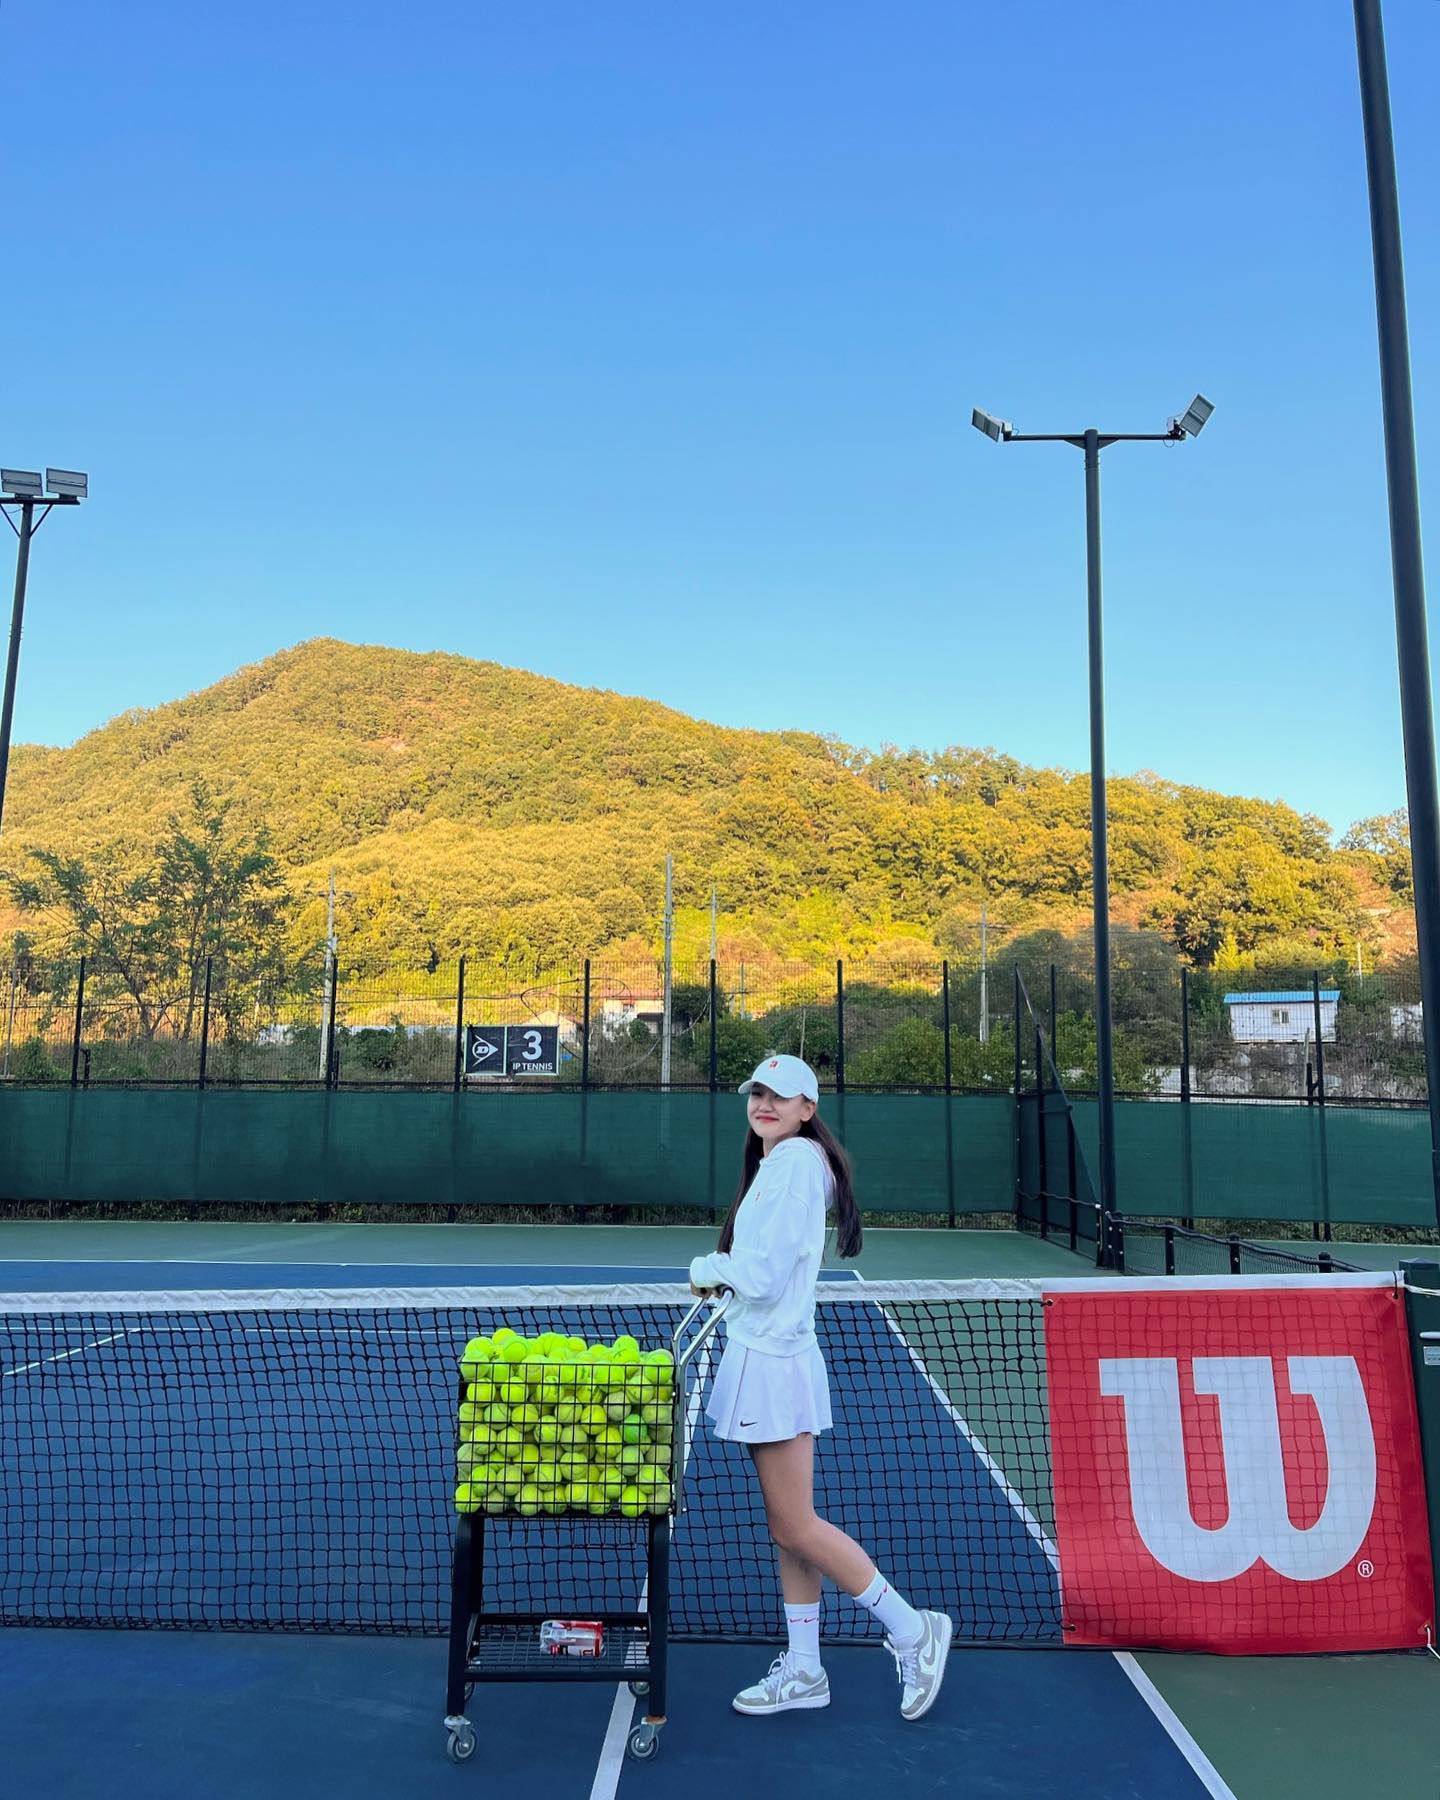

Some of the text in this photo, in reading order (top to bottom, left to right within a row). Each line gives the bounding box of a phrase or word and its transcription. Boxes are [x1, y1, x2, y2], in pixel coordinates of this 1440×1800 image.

[522, 1030, 542, 1060] 3
[512, 1062, 553, 1070] IP TENNIS
